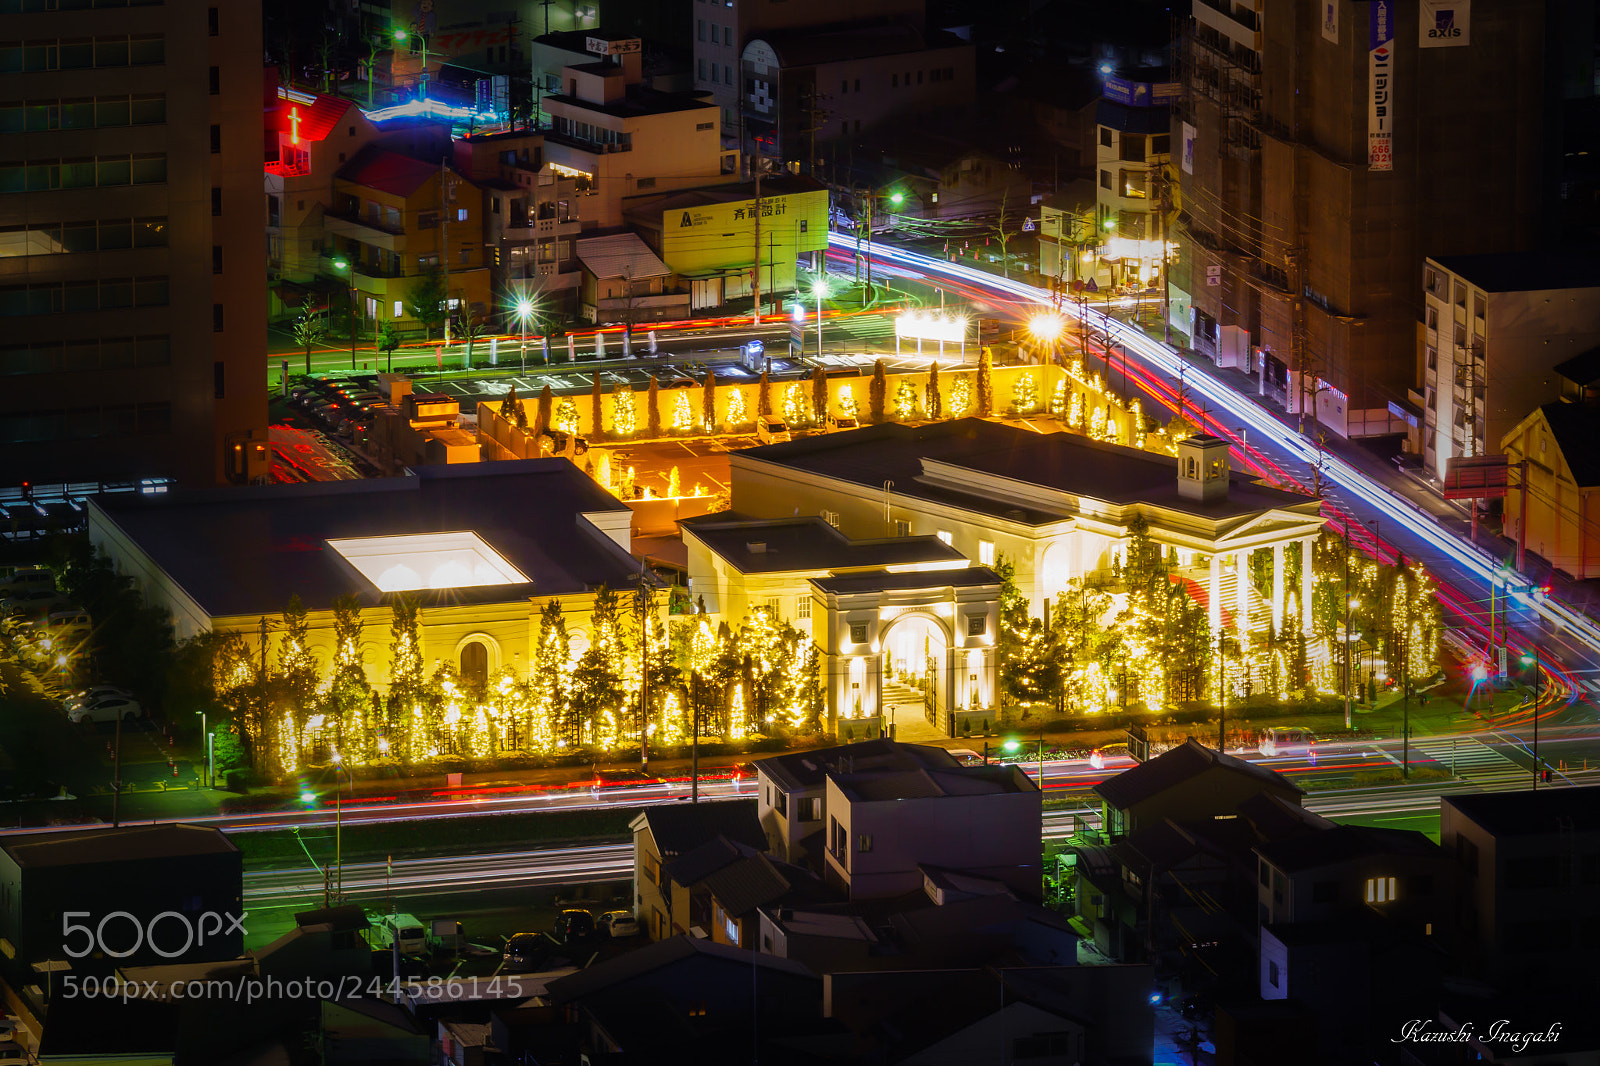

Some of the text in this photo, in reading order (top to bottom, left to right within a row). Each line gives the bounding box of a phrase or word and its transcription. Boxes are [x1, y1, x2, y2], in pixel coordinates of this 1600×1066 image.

[1428, 27, 1461, 38] axis
[1374, 63, 1388, 130] ニッショー
[1372, 145, 1390, 154] 266
[1369, 153, 1392, 163] 1321
